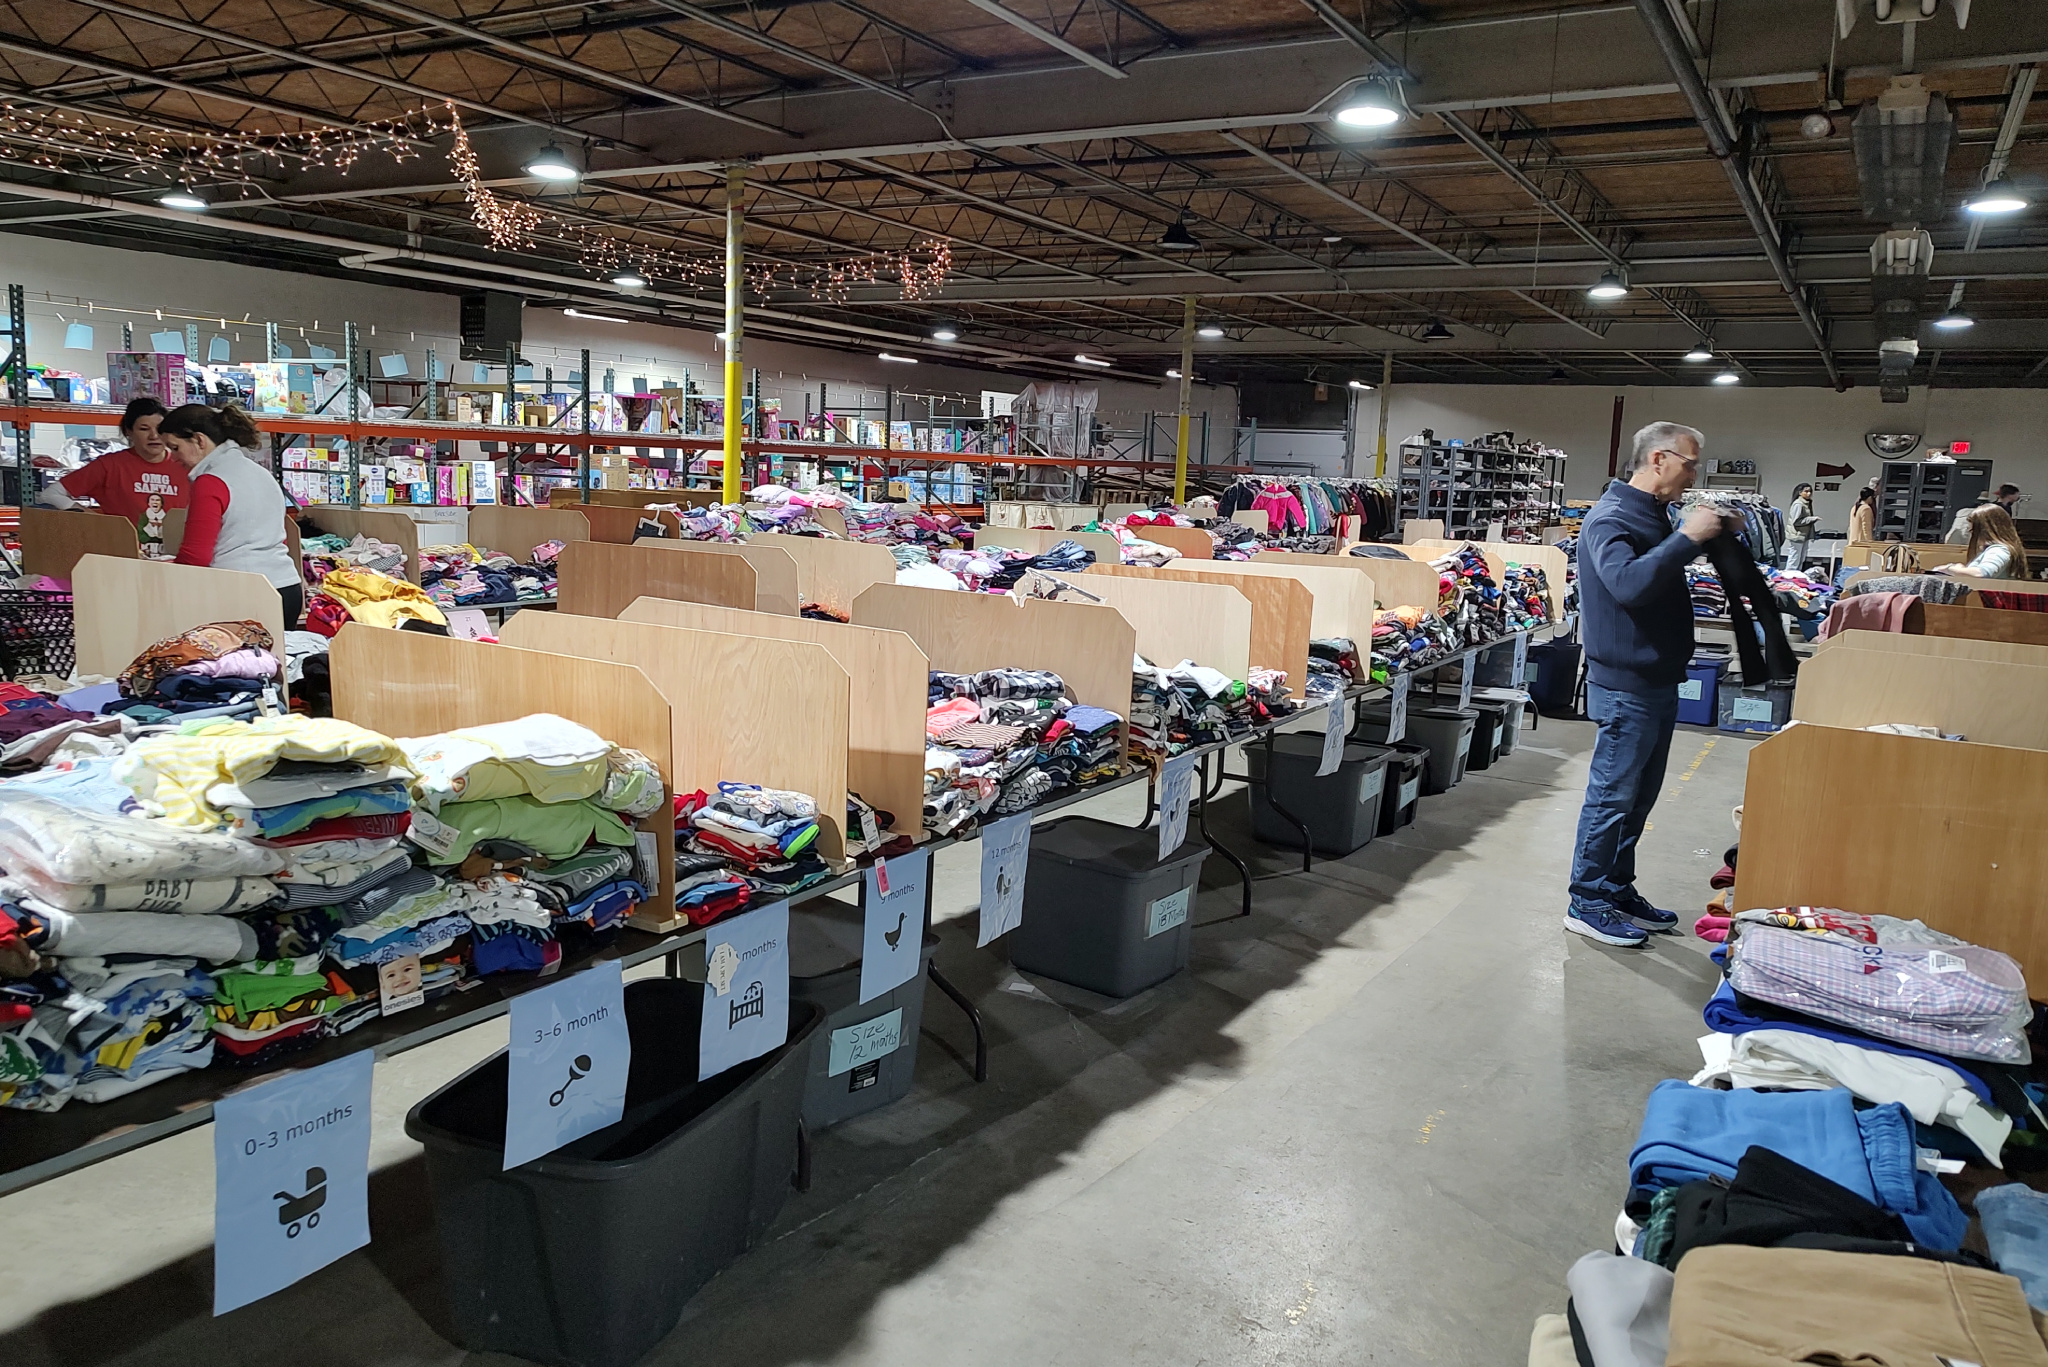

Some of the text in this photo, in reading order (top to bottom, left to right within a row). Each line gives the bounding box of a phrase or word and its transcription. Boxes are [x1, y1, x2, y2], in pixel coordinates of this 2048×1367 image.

[141, 473, 170, 485] OMG
[1814, 482, 1842, 491] EXIT
[134, 482, 178, 496] SANTA!
[991, 847, 1000, 859] 12
[145, 878, 195, 900] BABY
[887, 883, 915, 902] months
[1158, 900, 1178, 916] Size
[742, 938, 777, 962] months
[384, 994, 422, 1011] onesies
[566, 1004, 610, 1033] month
[850, 1022, 887, 1044] Size
[848, 1044, 868, 1065] 12
[244, 1103, 354, 1157] 0-3 months
